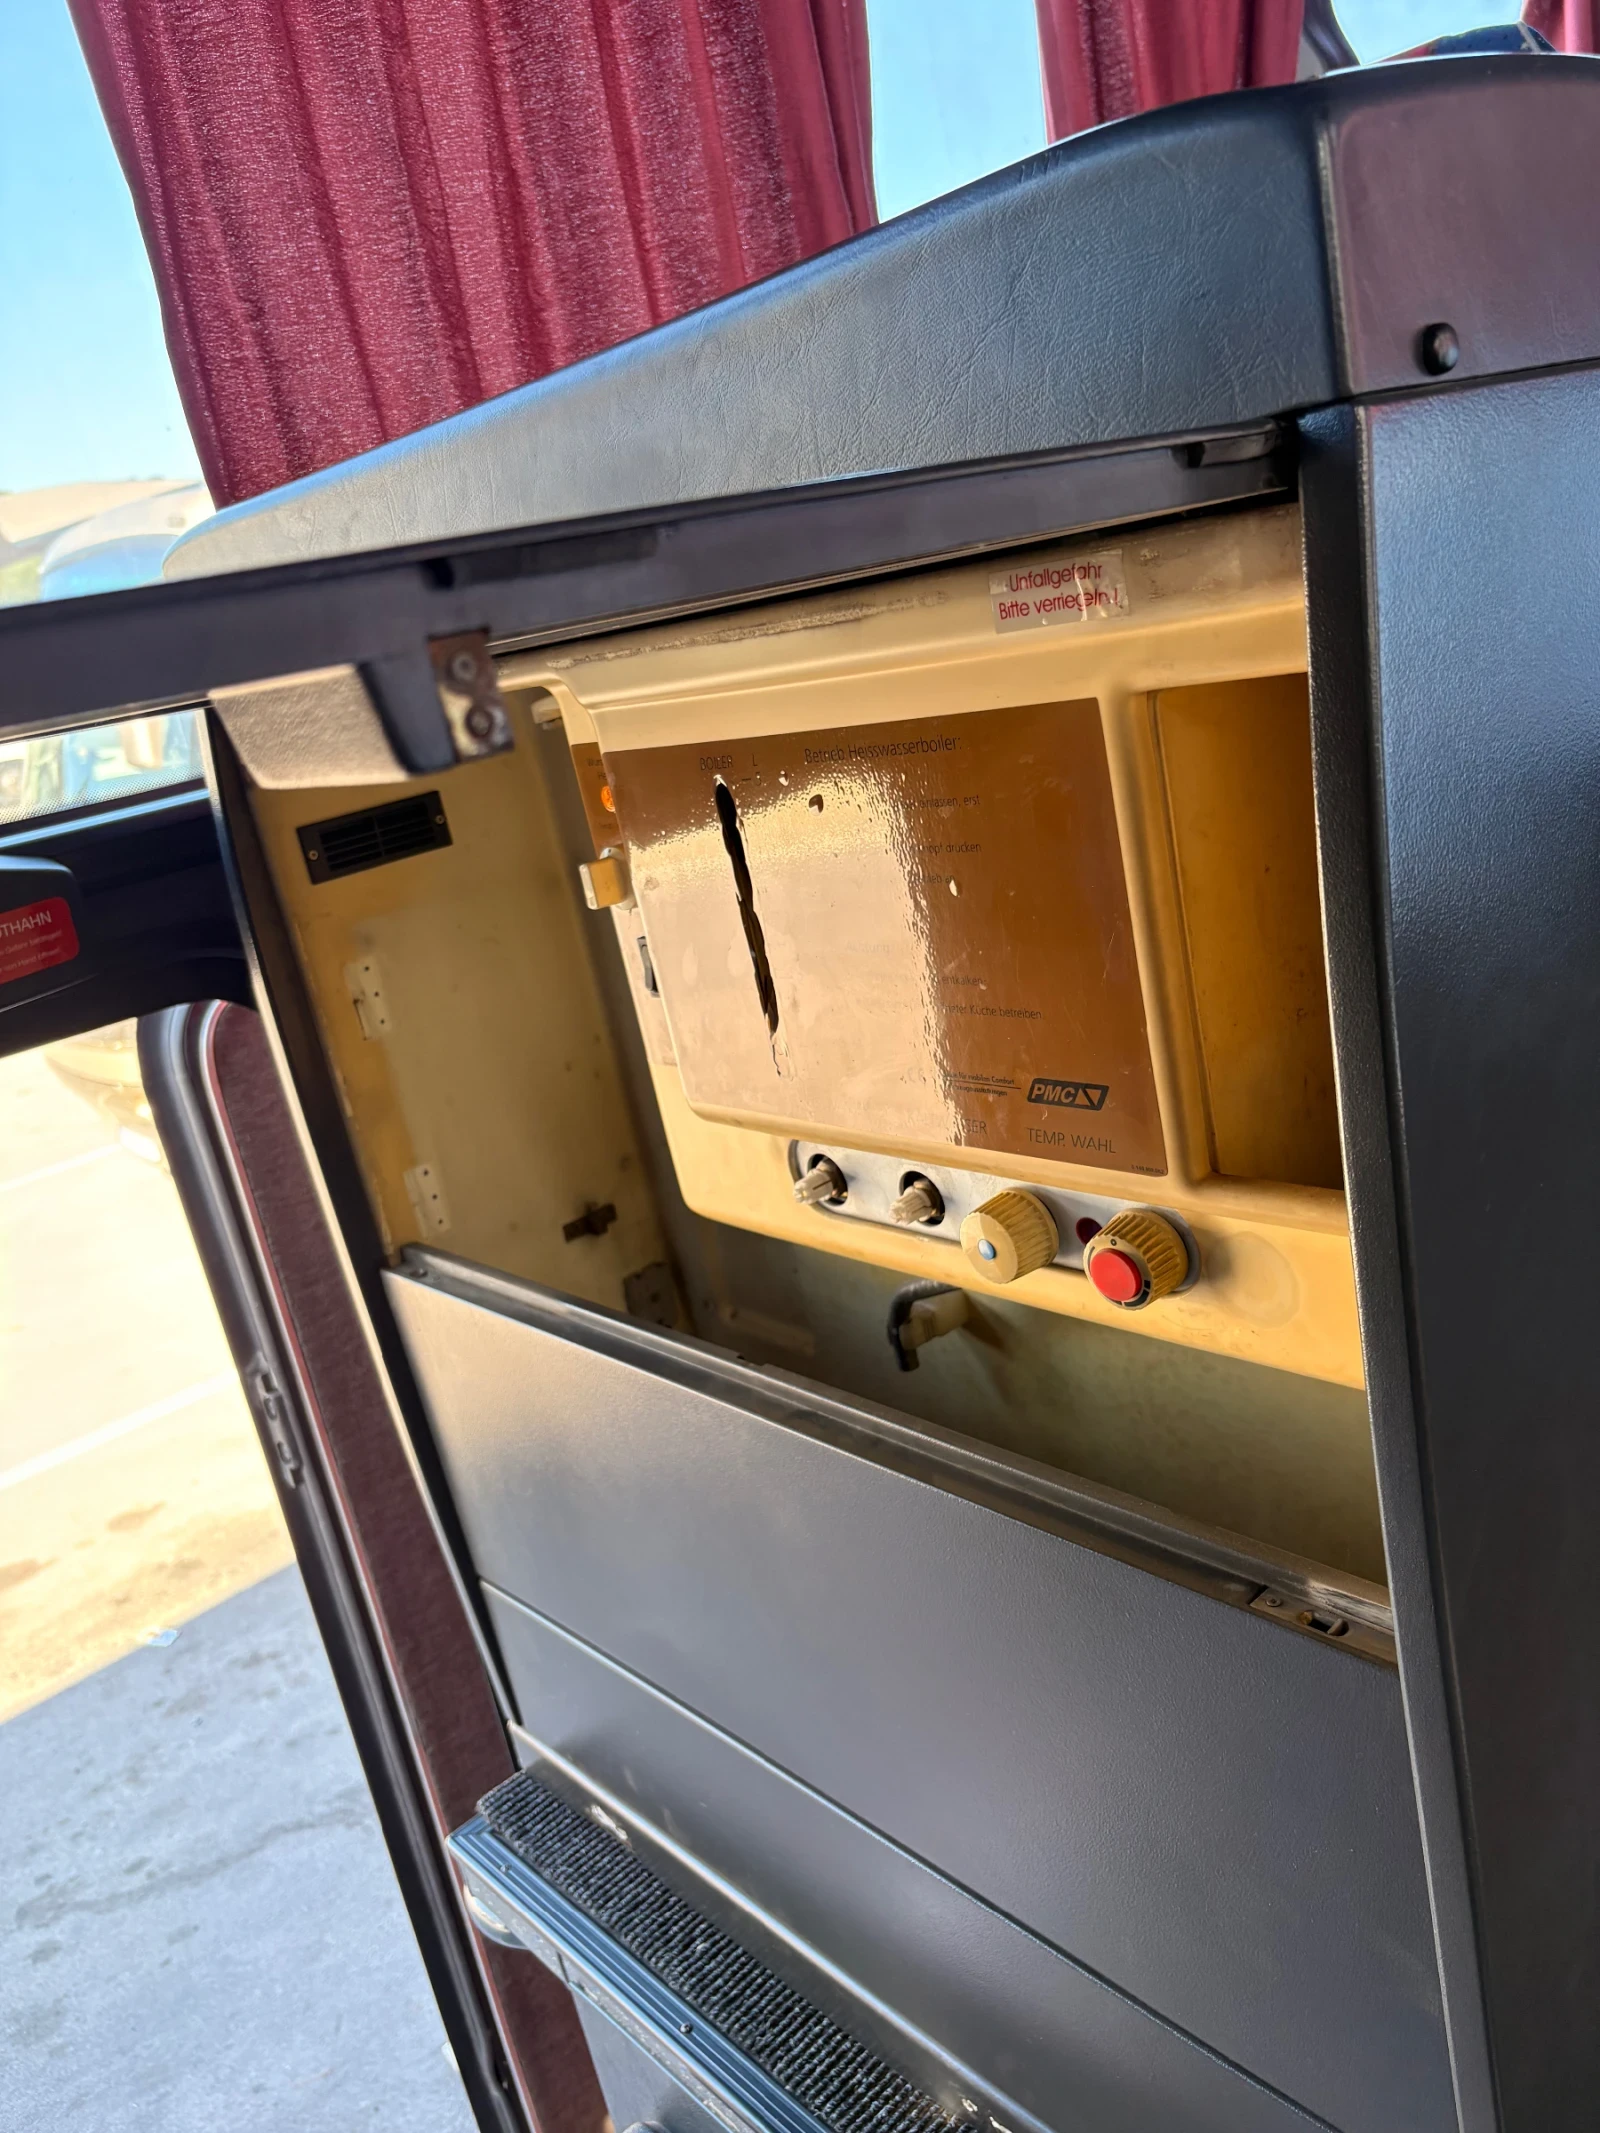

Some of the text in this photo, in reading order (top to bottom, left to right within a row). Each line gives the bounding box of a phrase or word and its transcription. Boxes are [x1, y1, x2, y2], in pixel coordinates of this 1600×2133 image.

[1009, 562, 1102, 592] Unfallgefahr
[999, 601, 1030, 620] Bitte
[804, 735, 962, 764] Betrieb Heisswasserboiler:
[700, 755, 733, 770] BOILER
[963, 795, 981, 806] erst
[999, 1006, 1042, 1020] betreiben
[1031, 1084, 1075, 1103] PMC
[1027, 1127, 1066, 1148] TEMP.
[1070, 1133, 1117, 1154] WAHL
